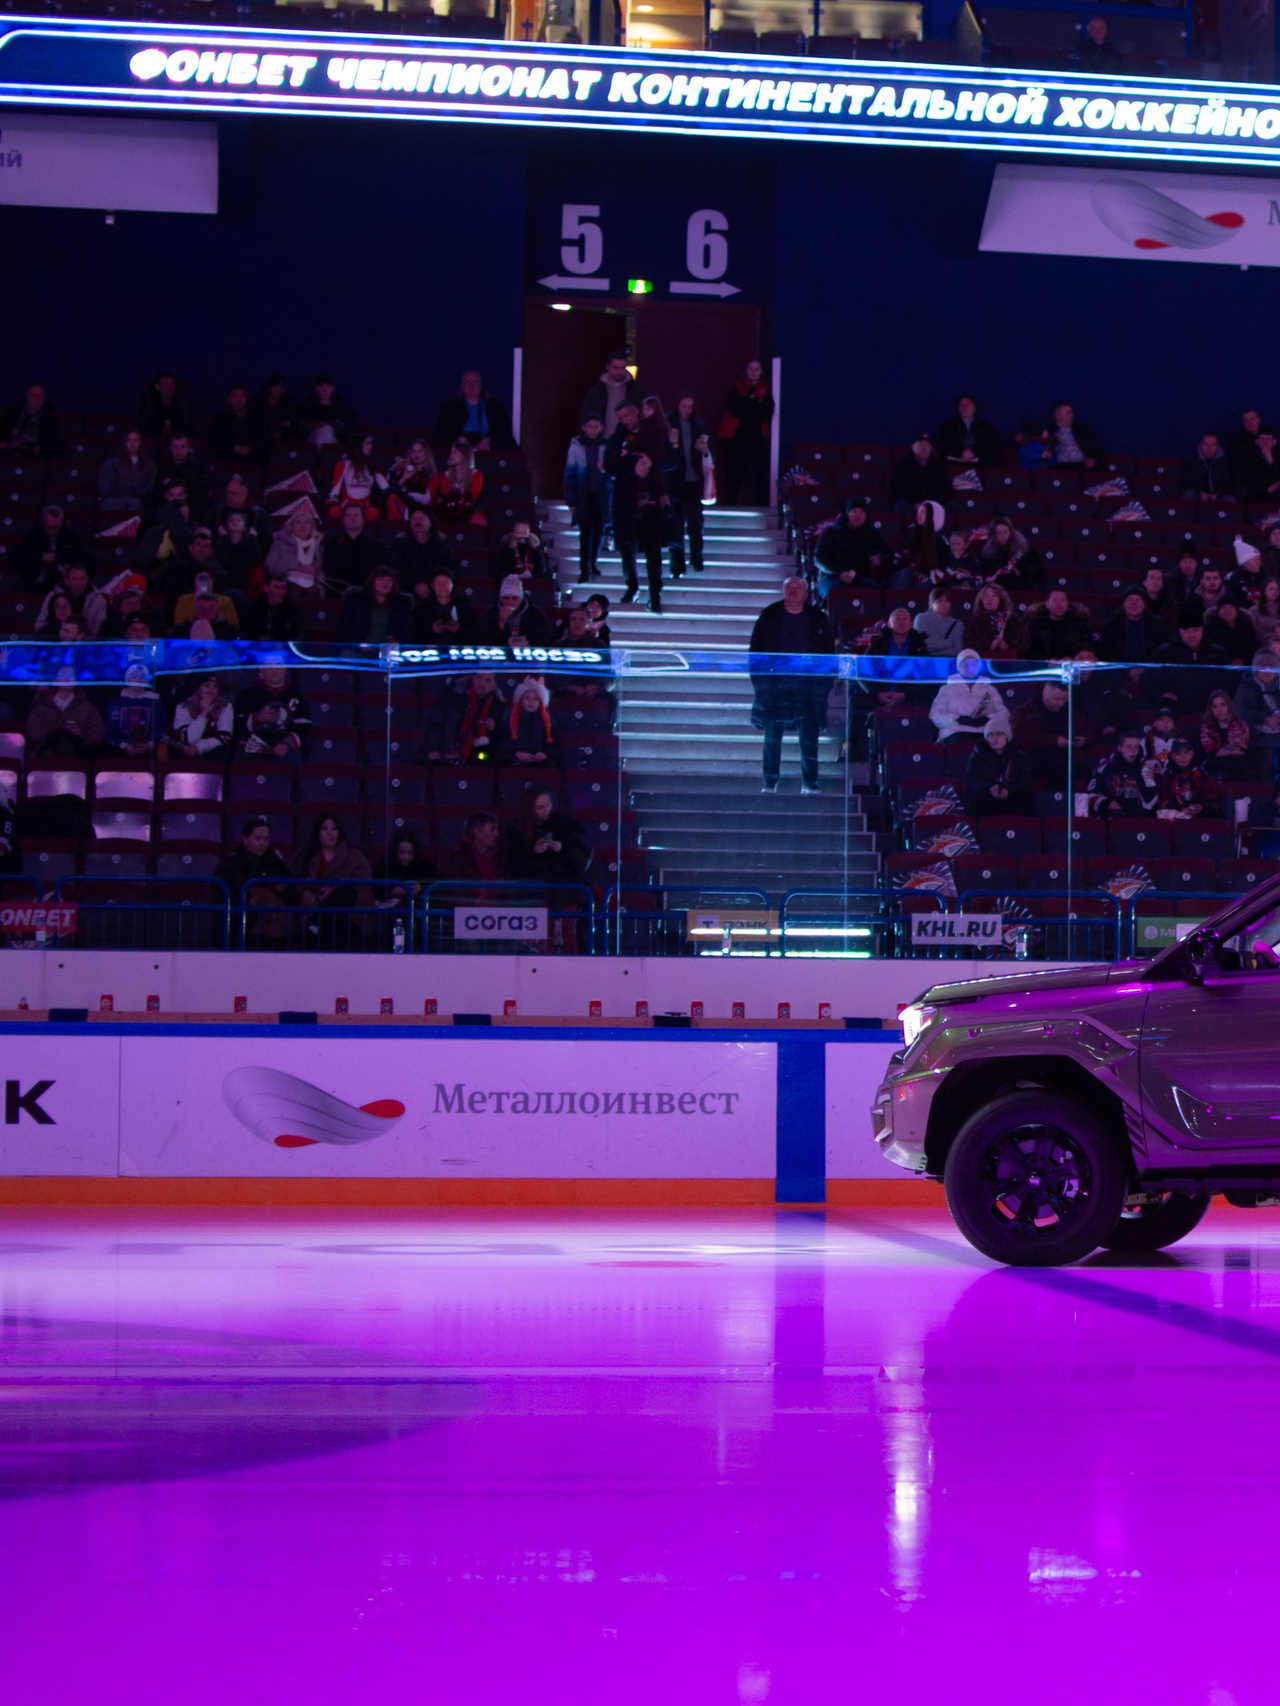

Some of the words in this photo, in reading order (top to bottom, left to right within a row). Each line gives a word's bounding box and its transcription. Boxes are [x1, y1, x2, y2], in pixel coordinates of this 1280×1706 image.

[130, 48, 317, 88] ФОНБЕТ
[327, 56, 602, 102] ЧЕМПИОНАТ
[607, 71, 1048, 126] КОНТИНЕНТАЛЬНОЙ
[561, 203, 603, 275] 5
[686, 209, 729, 281] 6
[464, 915, 538, 931] согаз
[916, 920, 997, 938] KHL.RU
[431, 1082, 740, 1117] Металлоинвест
